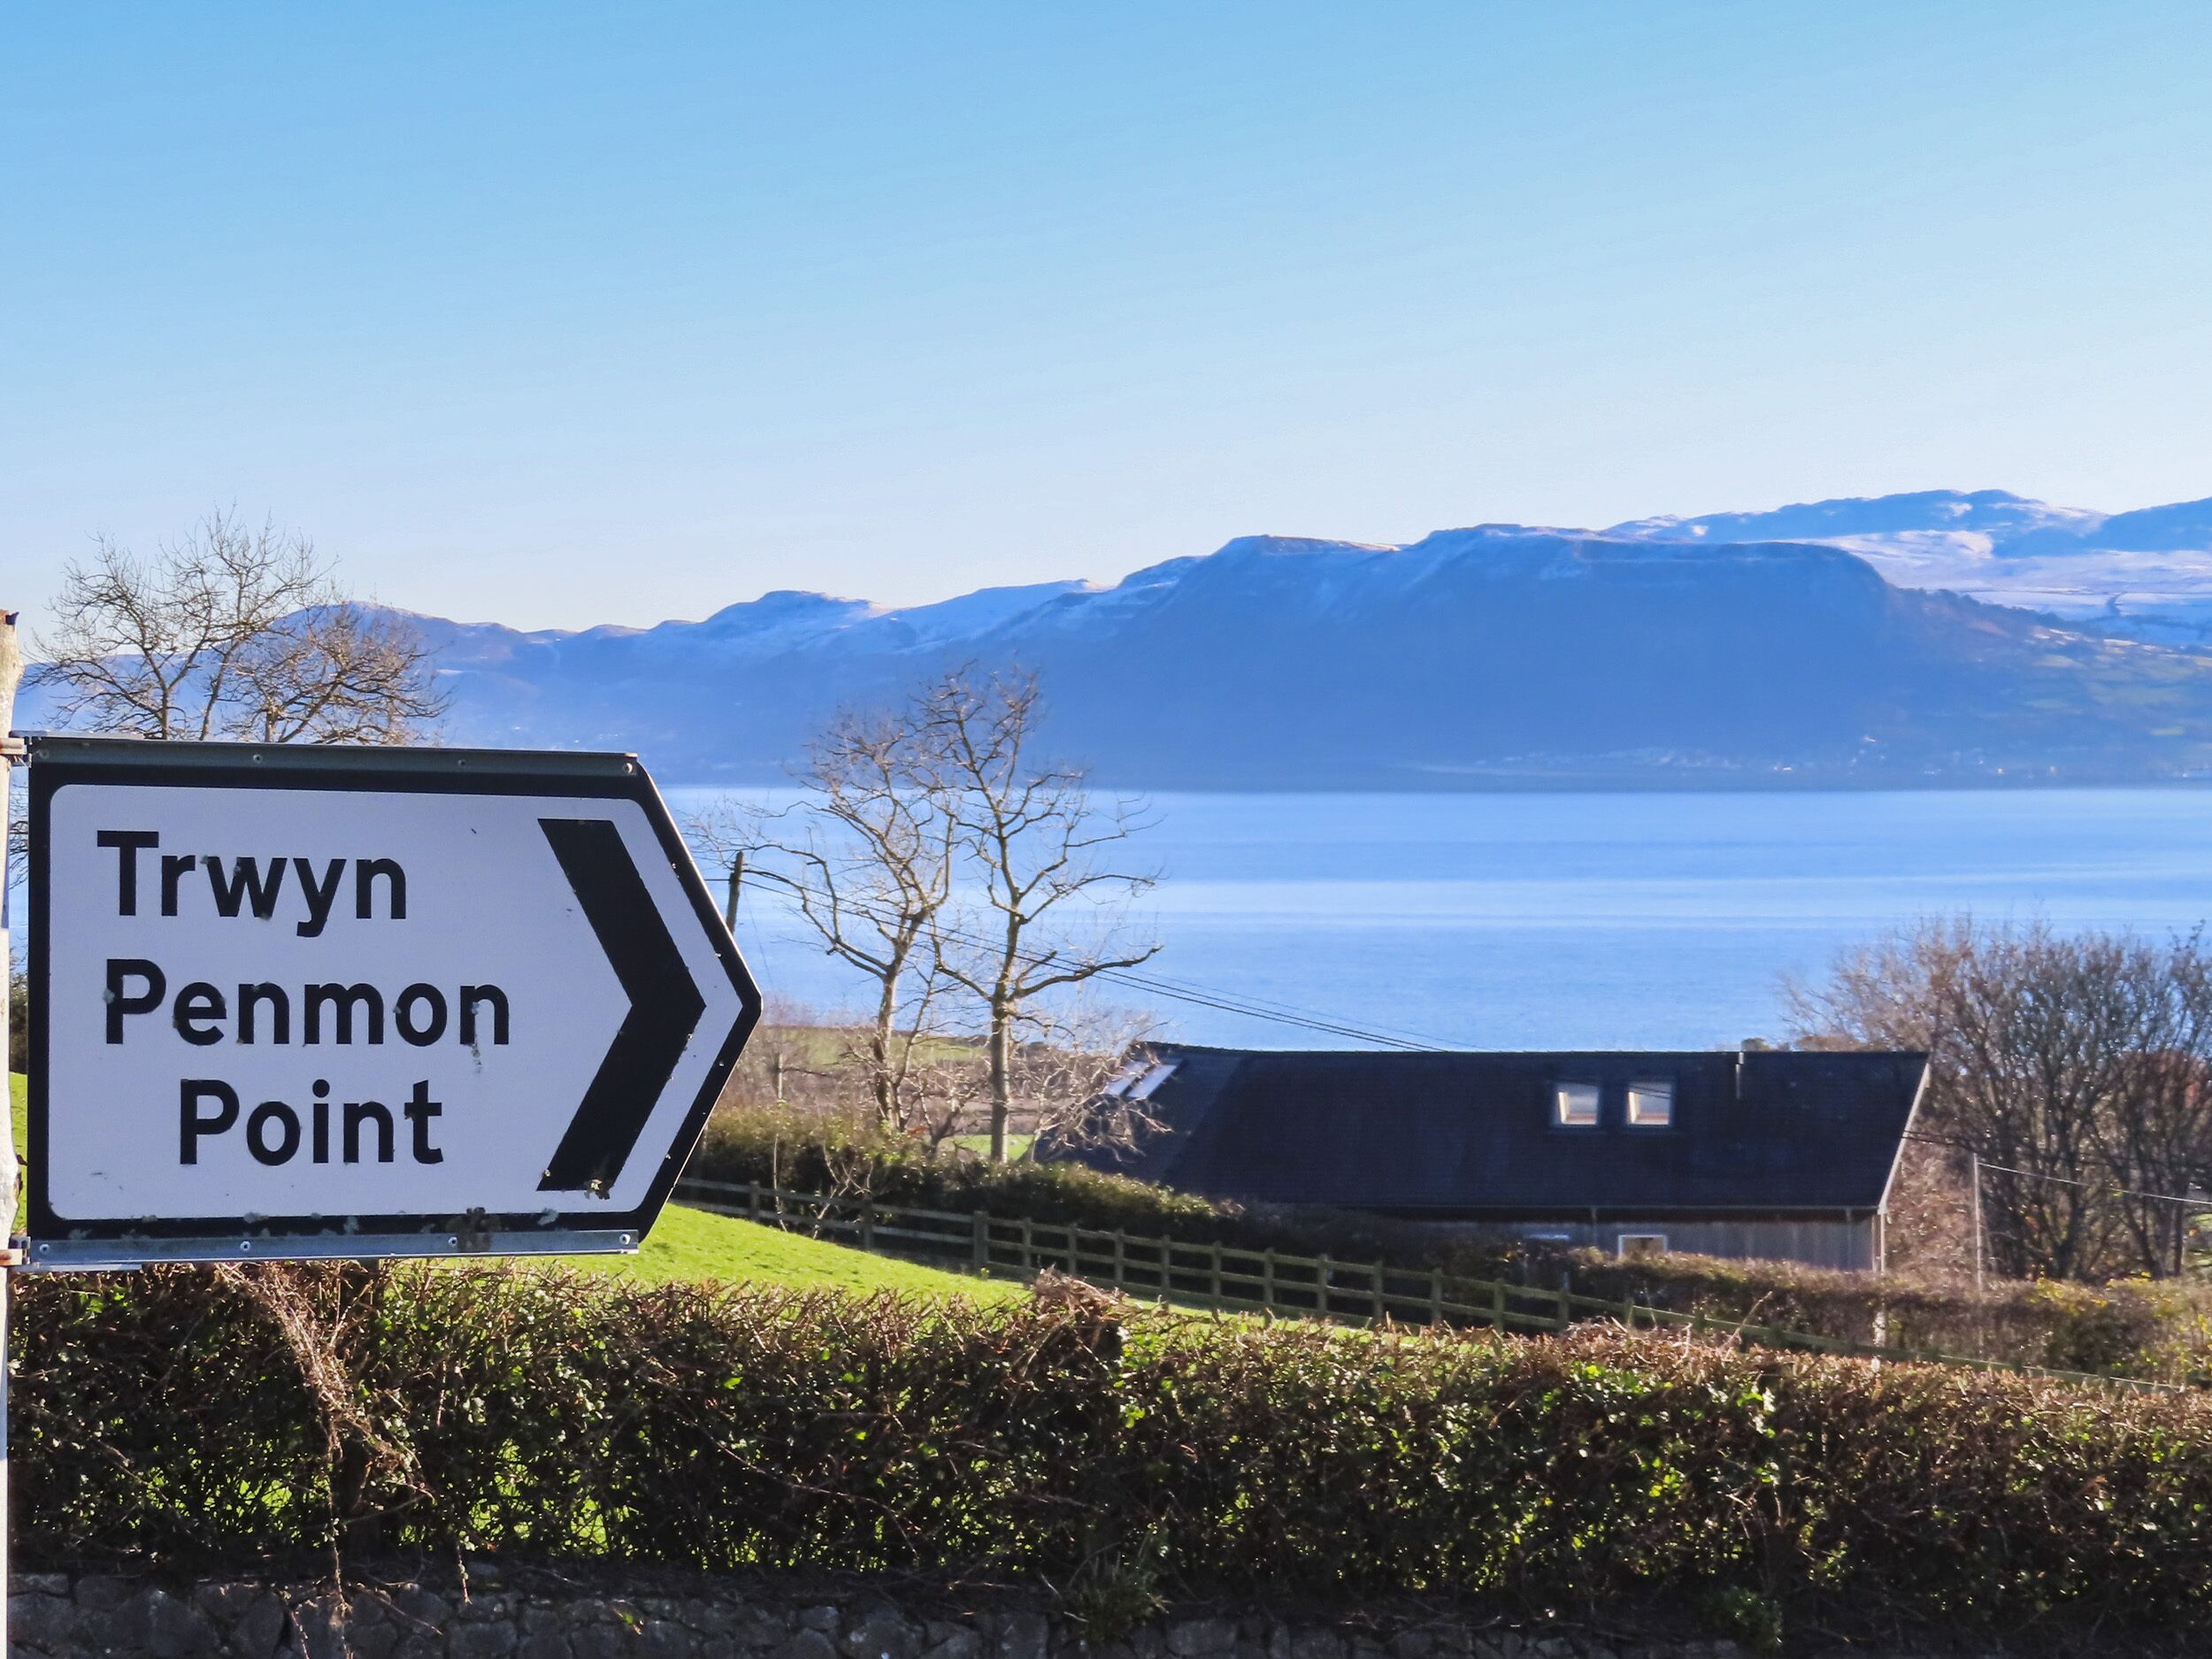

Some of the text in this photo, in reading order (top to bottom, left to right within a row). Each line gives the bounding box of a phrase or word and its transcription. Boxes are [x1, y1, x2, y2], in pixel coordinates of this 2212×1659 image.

[96, 829, 408, 939] Trwyn
[104, 958, 511, 1048] Penmon
[179, 1078, 444, 1166] Point
